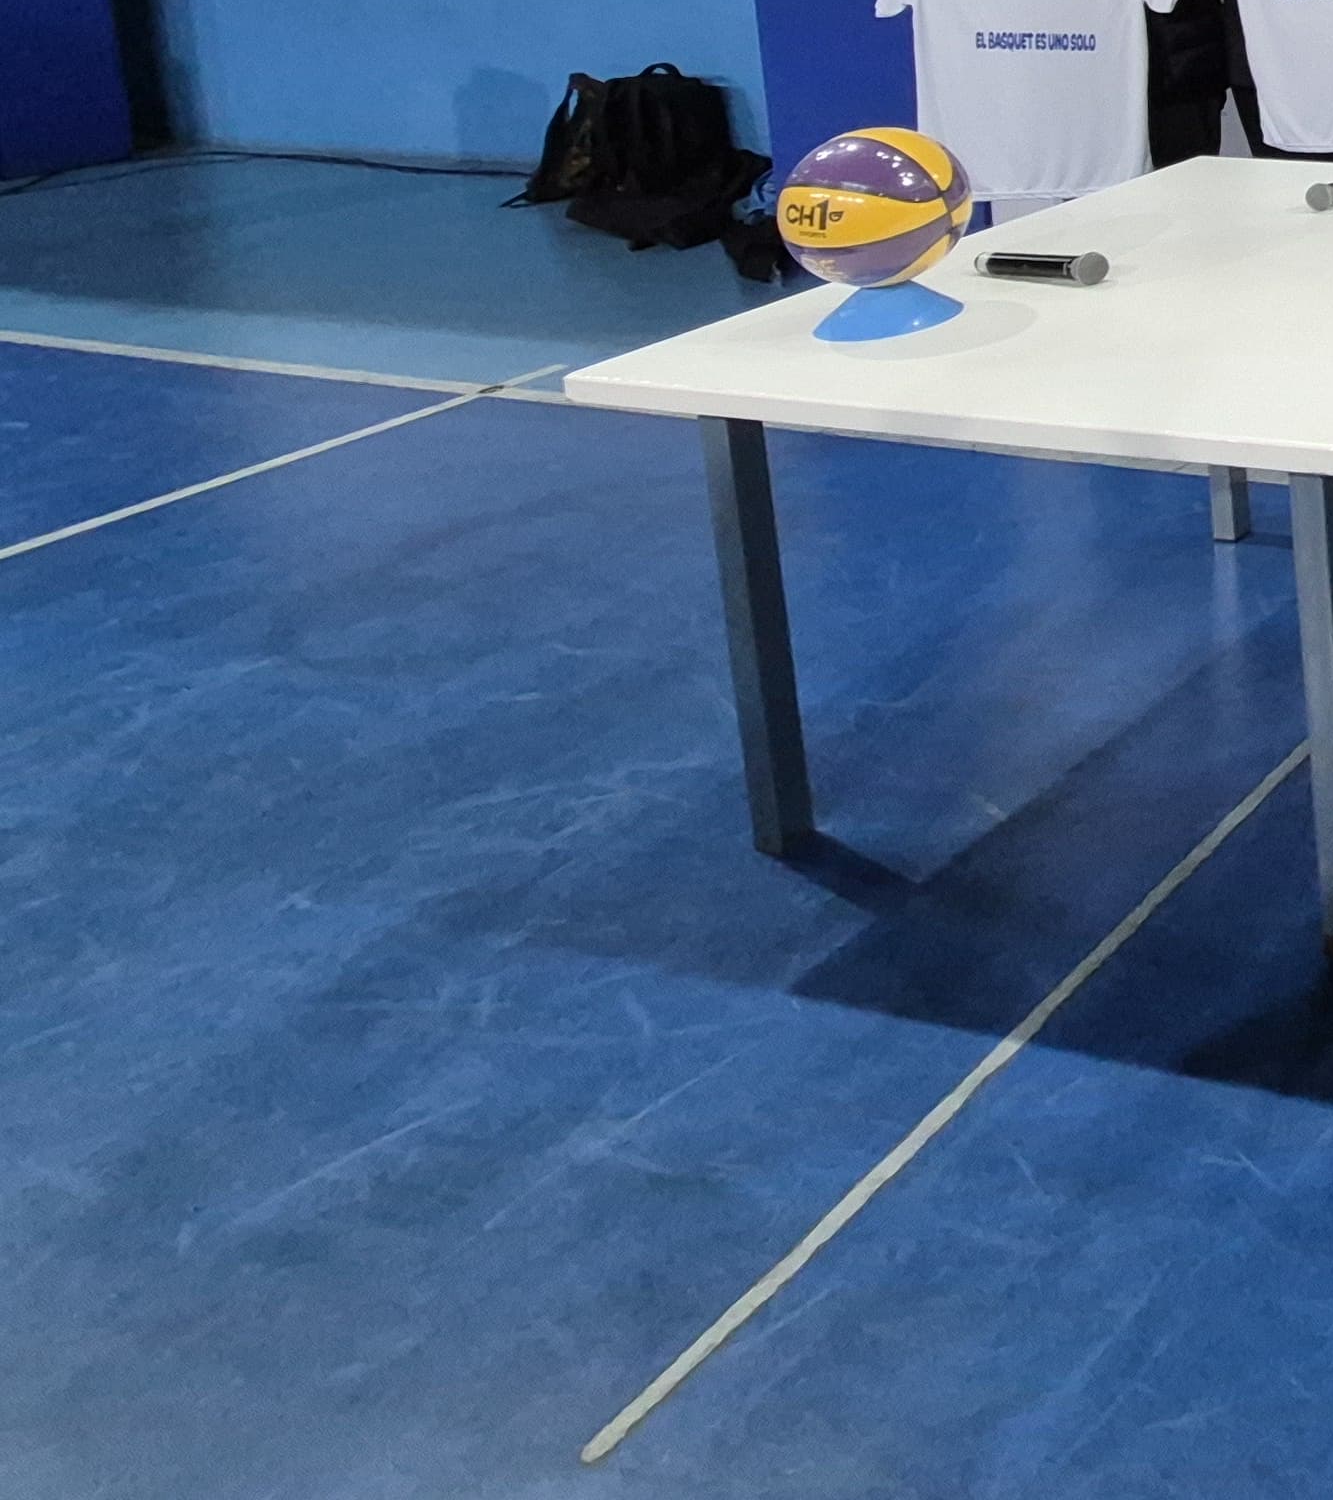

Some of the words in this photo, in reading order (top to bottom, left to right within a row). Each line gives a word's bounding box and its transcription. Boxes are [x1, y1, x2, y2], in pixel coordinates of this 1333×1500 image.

[976, 32, 987, 49] EL
[988, 32, 1034, 51] BASQUET
[1035, 32, 1047, 50] ES
[1048, 33, 1069, 50] UNO
[1070, 34, 1096, 51] SOLO
